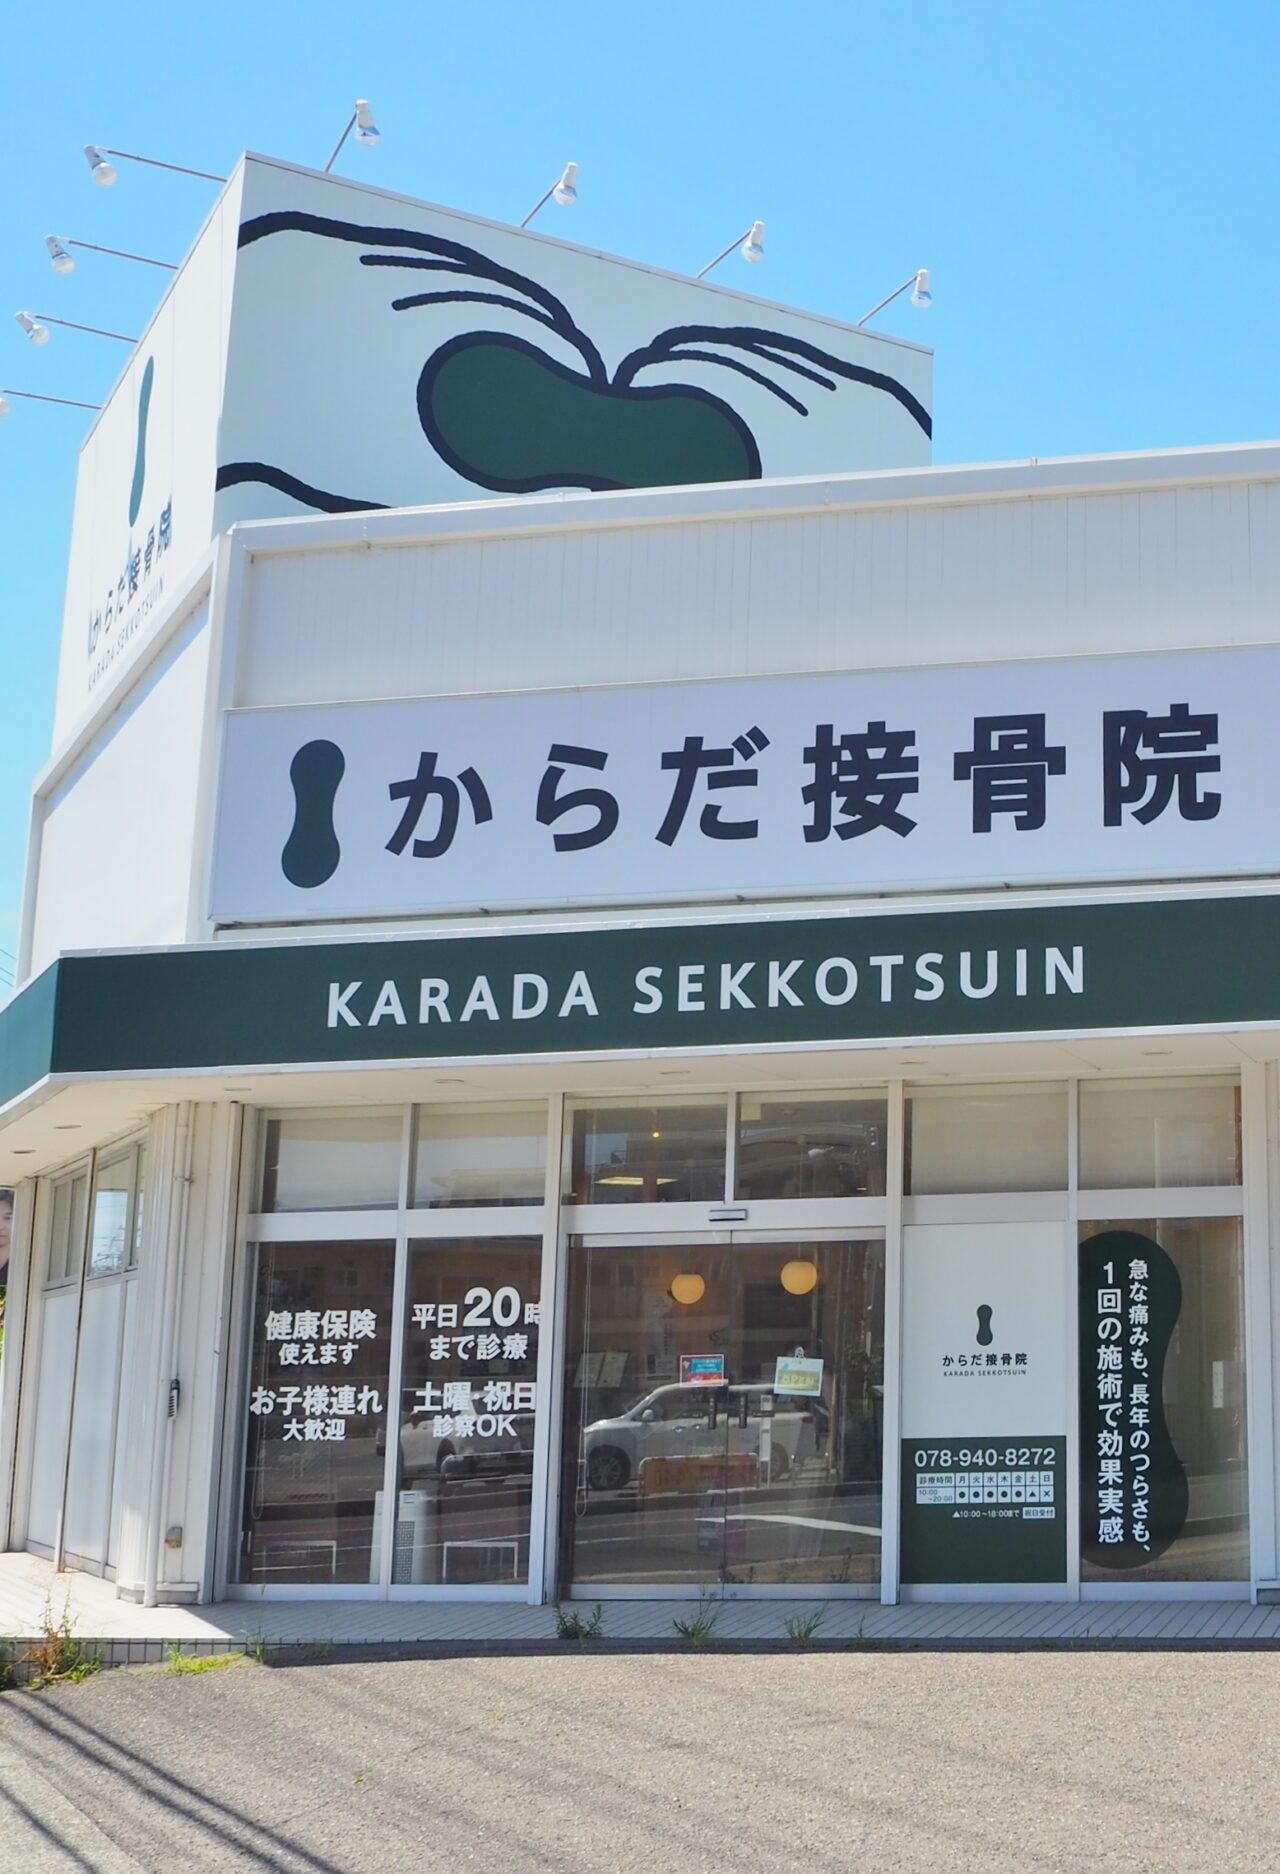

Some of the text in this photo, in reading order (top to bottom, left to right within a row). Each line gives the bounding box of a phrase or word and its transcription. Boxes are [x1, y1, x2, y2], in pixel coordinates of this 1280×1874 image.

[386, 703, 1222, 859] からだ接骨院
[327, 945, 1086, 1028] KARADA SEKKOTSUIN
[264, 1309, 378, 1341] 健康保険
[279, 1342, 359, 1366] 使えます
[429, 1333, 529, 1361] まで診療
[942, 1353, 1028, 1367] からだ接骨院
[977, 1369, 1027, 1377] SEKKOTSUIN
[250, 1384, 384, 1417] お子様連れ
[1097, 1261, 1124, 1545] 1回の施術で効果実感
[282, 1418, 346, 1442] 大歓迎
[914, 1447, 1056, 1468] 078-940-8272
[919, 1474, 1051, 1485] 診療時間 月 火 水 木 金 土 日
